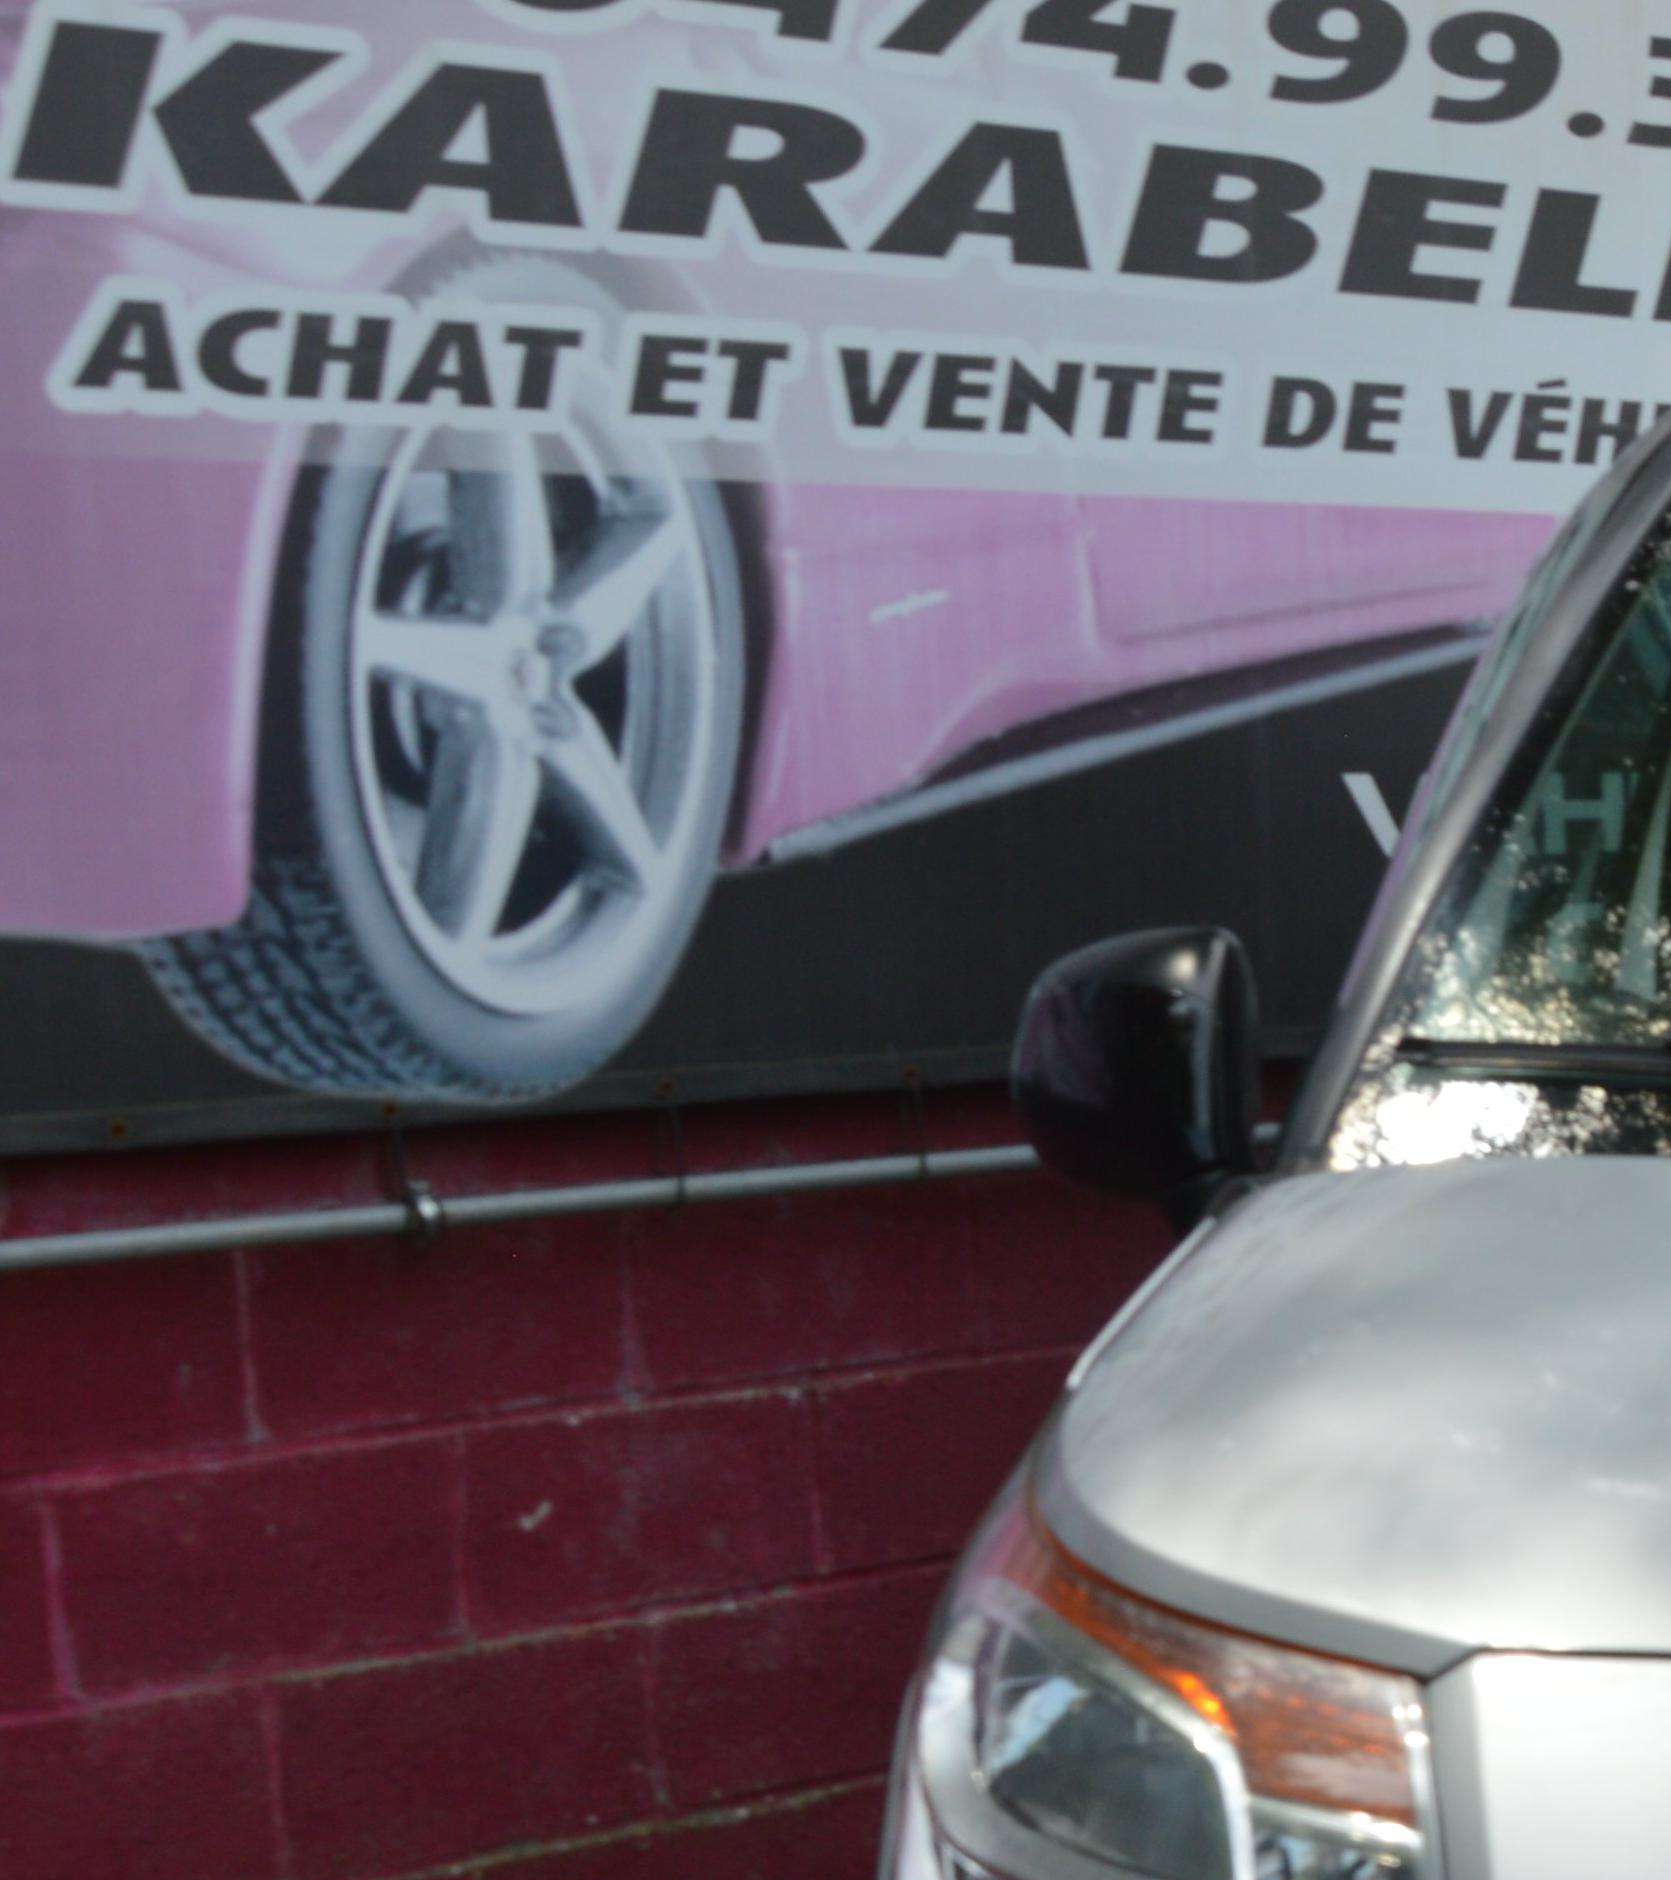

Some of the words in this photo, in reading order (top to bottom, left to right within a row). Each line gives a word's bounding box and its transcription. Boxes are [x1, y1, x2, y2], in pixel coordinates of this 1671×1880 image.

[74, 300, 582, 410] ACHAT
[629, 335, 788, 420] ET
[839, 348, 1223, 443] VENTE
[1262, 376, 1405, 454] DE
